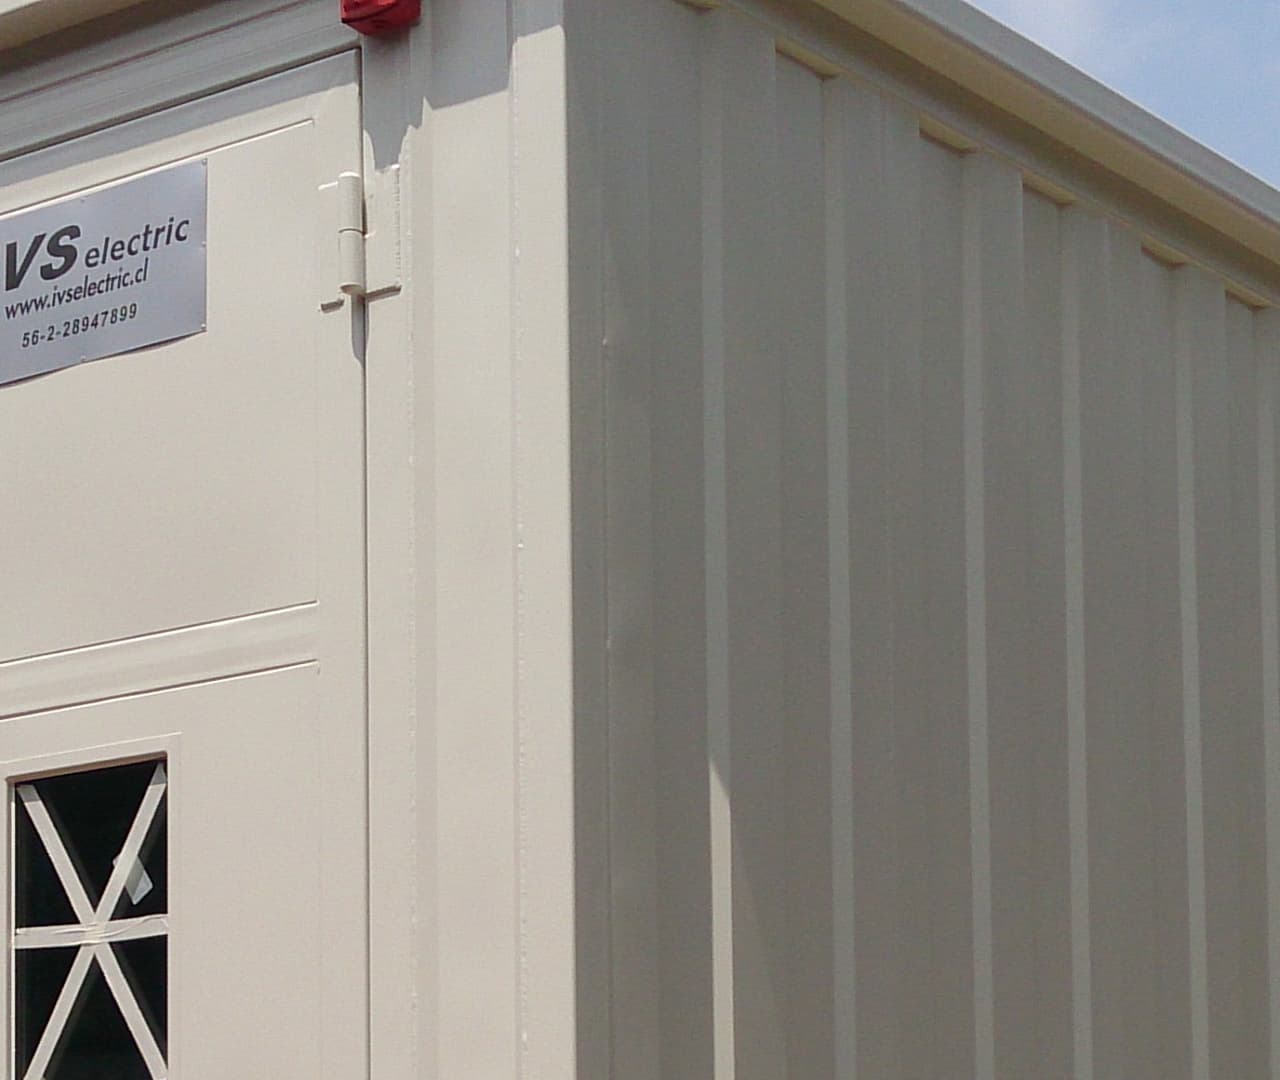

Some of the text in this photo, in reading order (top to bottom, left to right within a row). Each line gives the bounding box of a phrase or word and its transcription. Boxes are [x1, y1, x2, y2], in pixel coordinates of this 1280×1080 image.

[85, 216, 189, 269] electric
[5, 258, 149, 320] www.ivselectric.cl
[22, 303, 137, 348] 56-2-28947899
